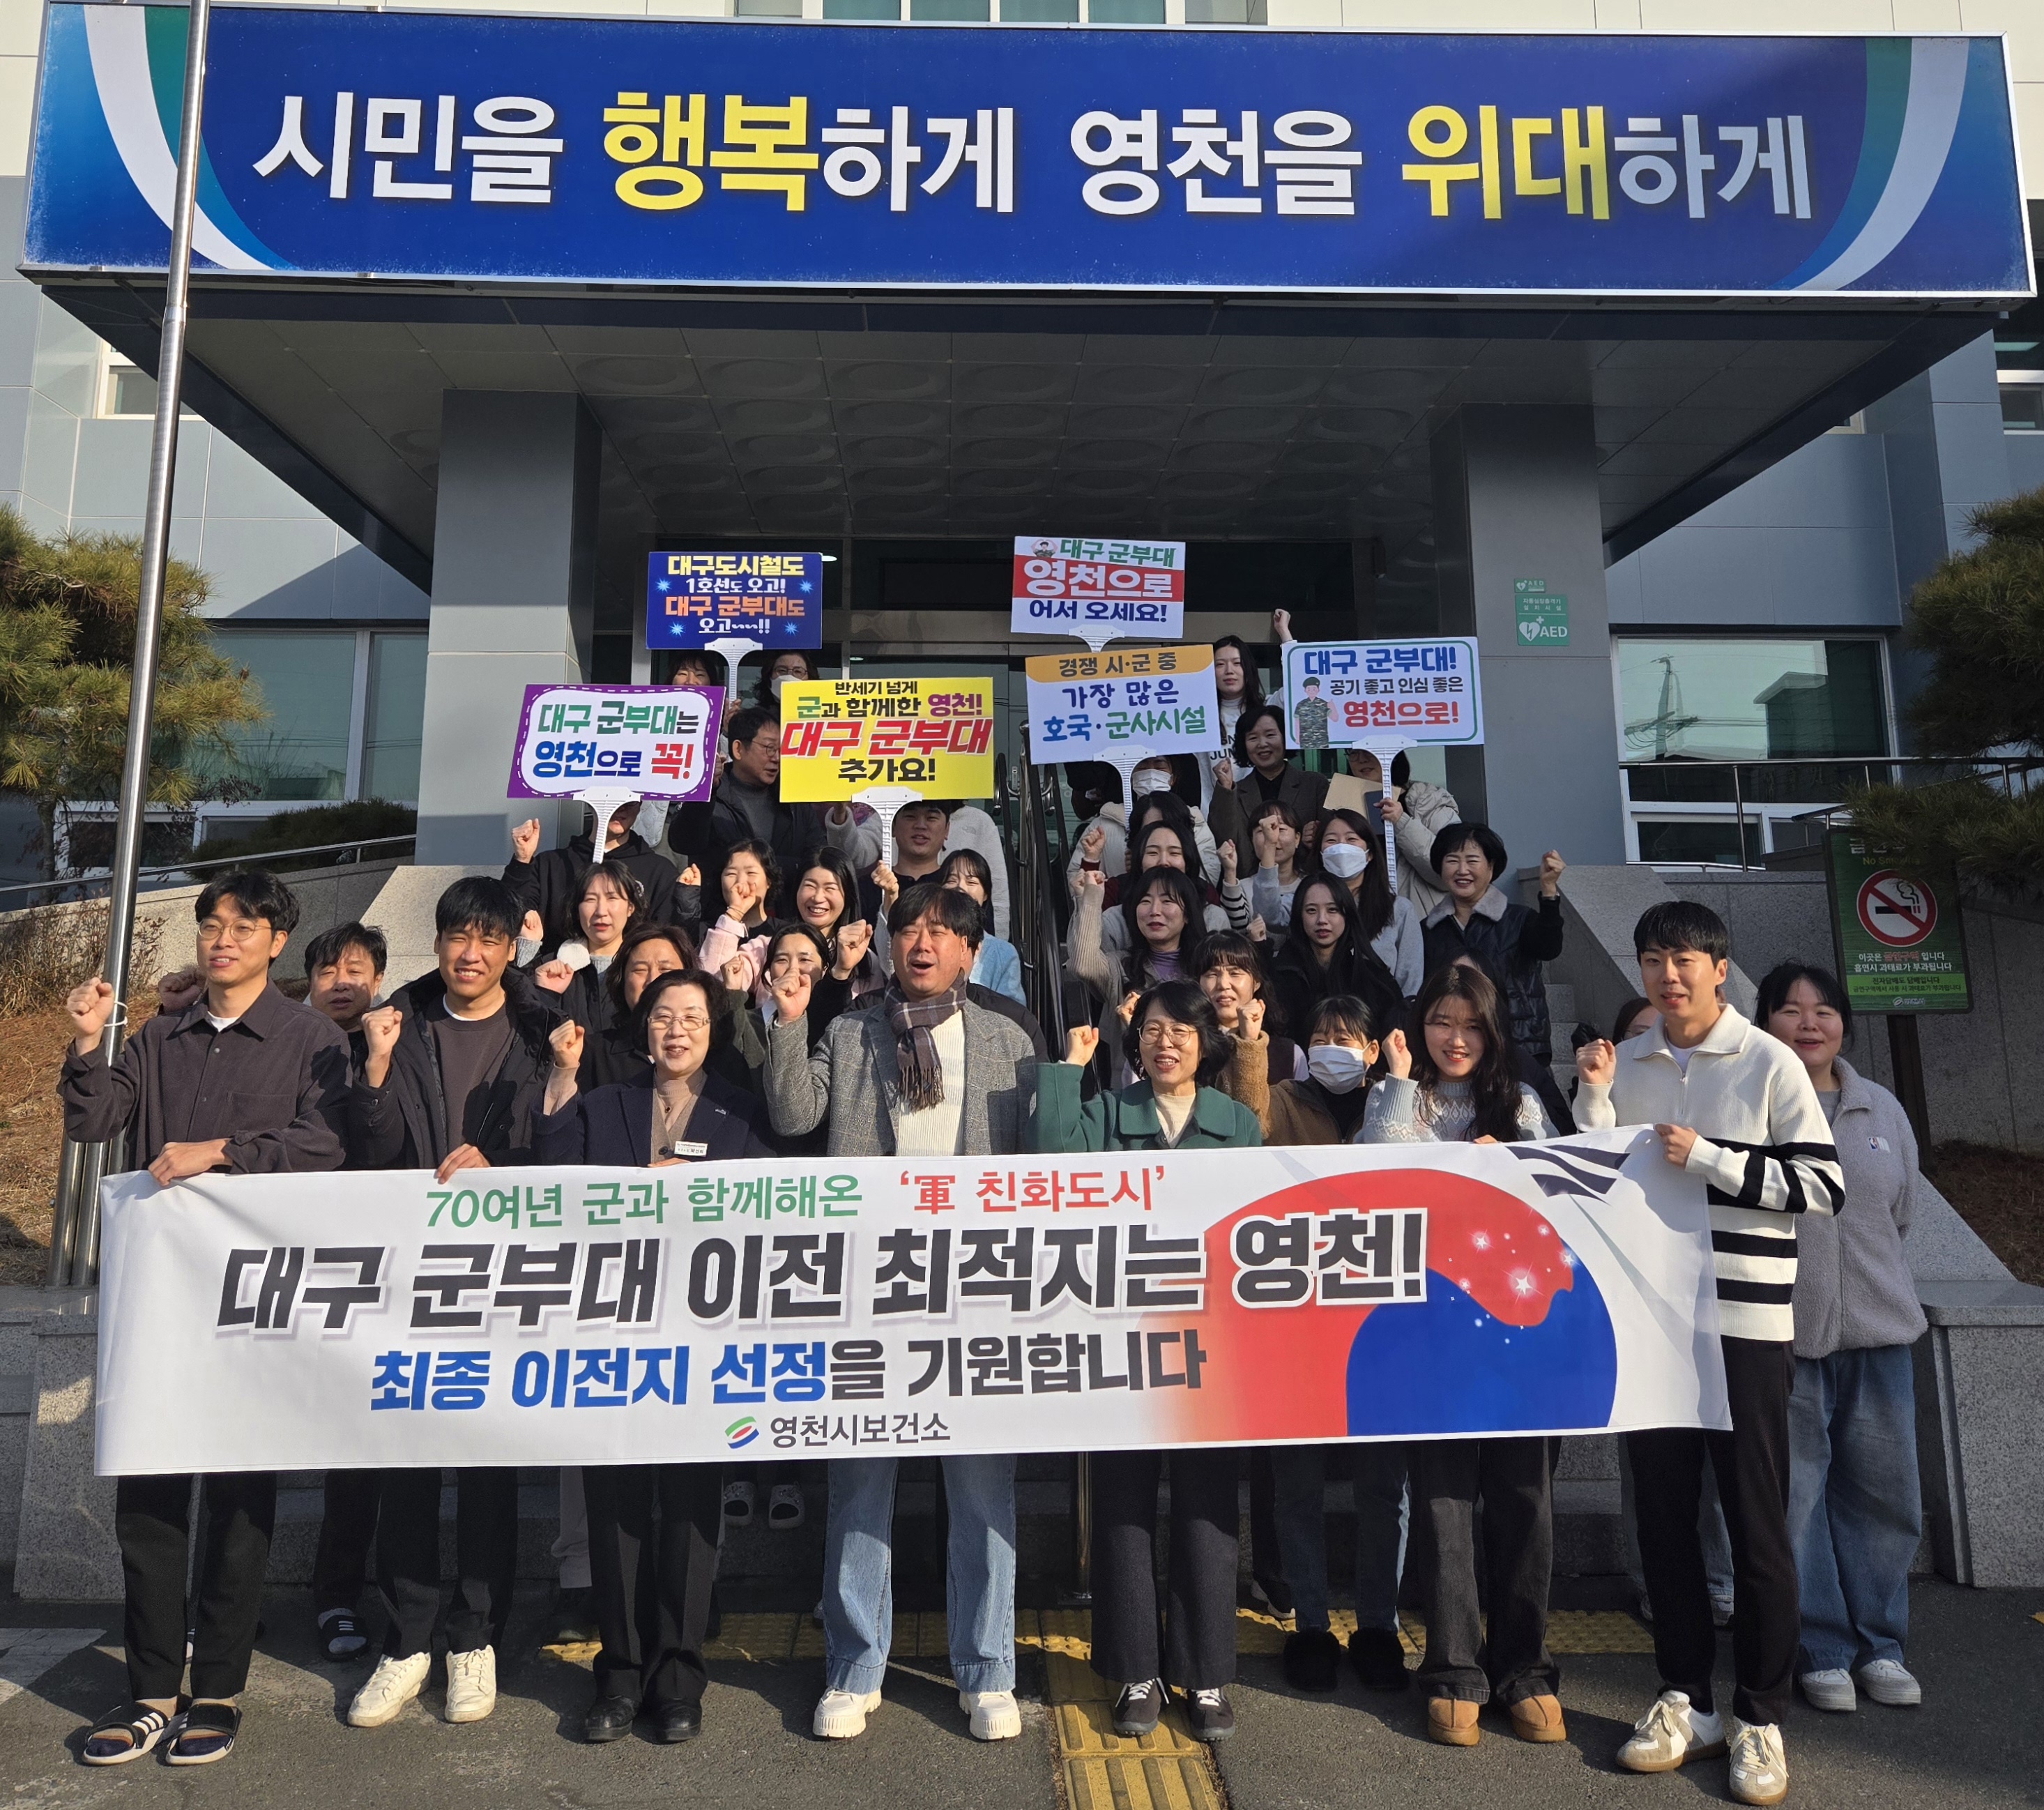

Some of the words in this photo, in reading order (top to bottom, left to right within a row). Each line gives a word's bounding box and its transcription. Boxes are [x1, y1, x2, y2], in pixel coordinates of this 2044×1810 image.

[252, 91, 564, 204] 시민을
[603, 91, 1014, 213] 행복하게
[1069, 109, 1363, 215] 영천을
[1402, 105, 1813, 220] 위대하게
[668, 556, 804, 575] 대구도시철도
[1060, 539, 1104, 560] 대구
[1108, 542, 1176, 568] 군부대
[686, 577, 742, 593] 1호선도
[747, 578, 786, 593] 오고!
[1023, 559, 1173, 598] 영천으로
[666, 596, 712, 616] 대구
[718, 596, 804, 616] 군부대도
[1029, 600, 1078, 619] 어서
[1085, 602, 1167, 623] 오세요!
[1540, 626, 1568, 637] AED
[1059, 657, 1097, 677] 경쟁
[1157, 652, 1177, 670] 중
[1304, 650, 1358, 675] 대구
[1366, 646, 1456, 674] 군부대!
[835, 681, 882, 695] 반세기
[886, 680, 917, 694] 넘게
[1062, 683, 1115, 709] 가장
[1126, 679, 1179, 706] 많은
[1330, 679, 1360, 695] 공기
[1364, 678, 1394, 694] 좋고
[1398, 677, 1428, 694] 인심
[1433, 676, 1463, 692] 좋은
[537, 704, 591, 733] 대구
[597, 701, 699, 735] 군부대는
[797, 696, 841, 718] 군과
[846, 697, 921, 717] 함께한
[928, 692, 982, 717] 영천!
[1343, 699, 1458, 727] 영천으로!
[781, 721, 862, 757] 대구
[869, 719, 993, 756] 군부대
[533, 740, 642, 778] 영천으로
[651, 743, 694, 779] 꼭!
[838, 758, 936, 782] 추가요!
[1862, 857, 1876, 865] No
[1854, 963, 1877, 973] 흡연시
[1879, 963, 1911, 973] 과태료가
[1912, 962, 1953, 972] 부과됩니다
[1859, 952, 1882, 962] 이곳은
[1921, 951, 1945, 961] 입니다
[426, 1182, 562, 1229] 70여년
[583, 1180, 669, 1225] 군과
[687, 1174, 863, 1222] 함께해온
[215, 1245, 387, 1330] 대구
[410, 1237, 660, 1329] 군부대
[687, 1232, 845, 1320] 이전
[872, 1224, 1206, 1314] 최적지는
[1231, 1208, 1428, 1307] 영천!
[370, 1349, 491, 1411] 최종
[512, 1344, 689, 1408] 이전지
[710, 1339, 886, 1404] 선정을
[908, 1330, 1207, 1397] 기원합니다
[769, 1412, 951, 1448] 영천시보건소
